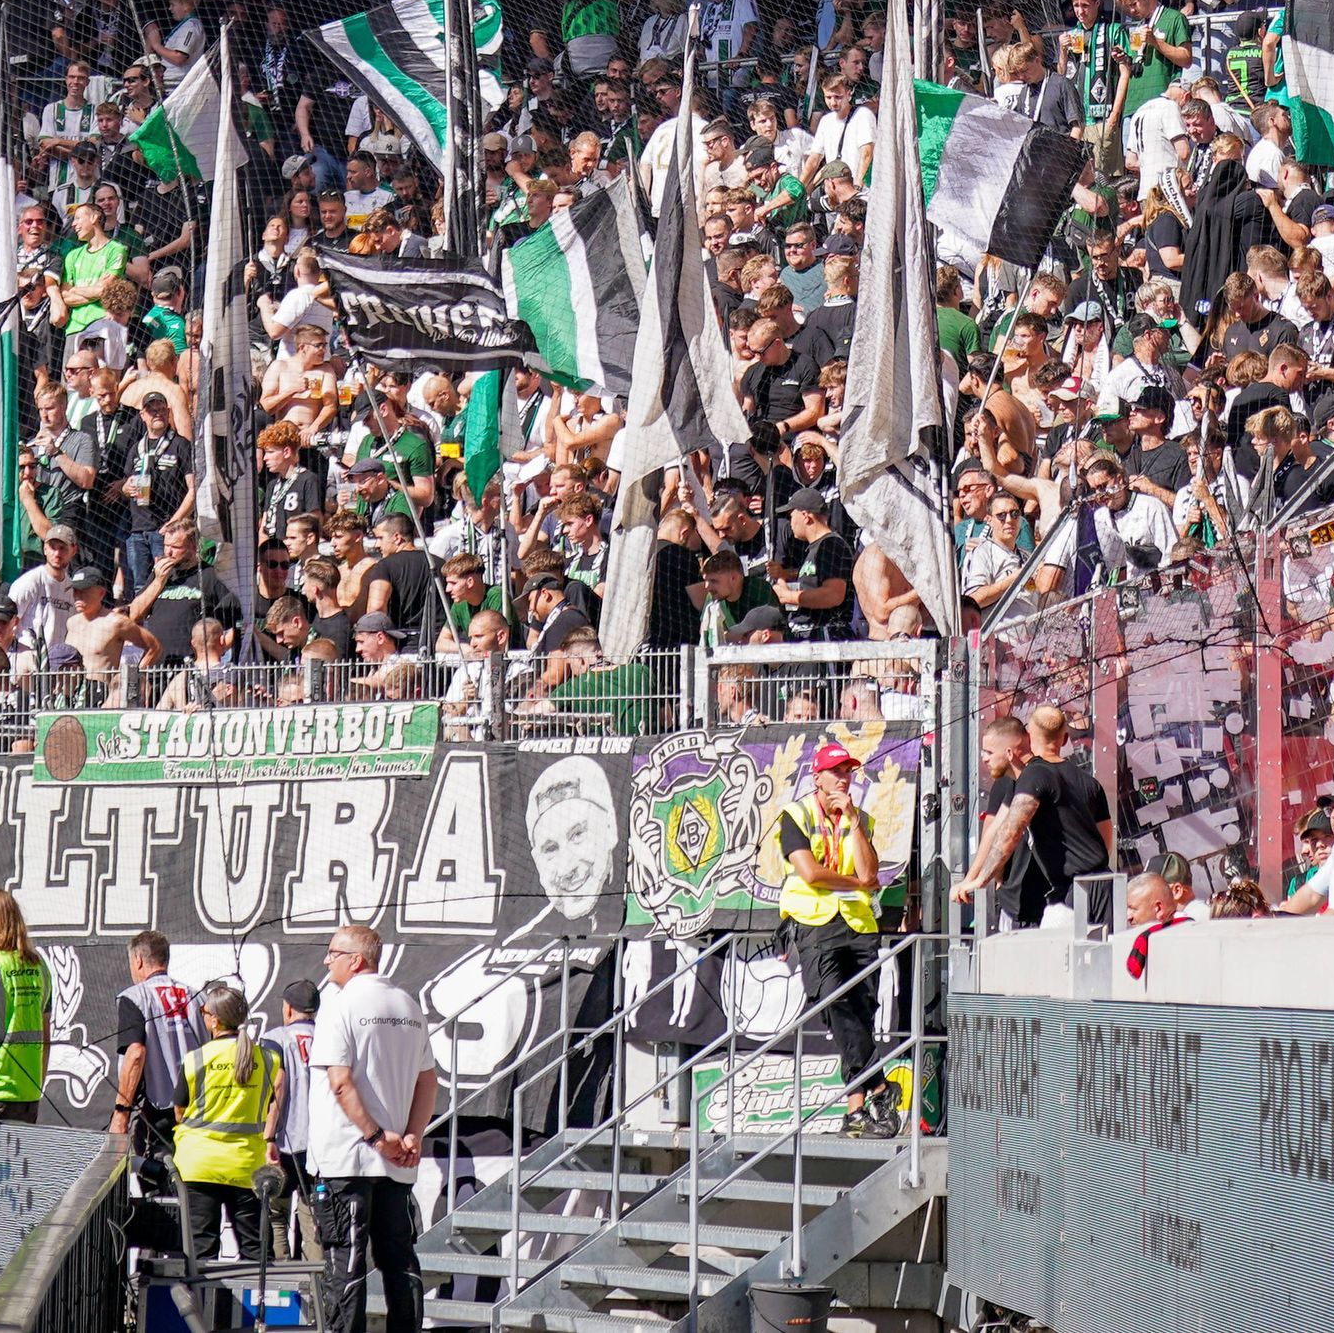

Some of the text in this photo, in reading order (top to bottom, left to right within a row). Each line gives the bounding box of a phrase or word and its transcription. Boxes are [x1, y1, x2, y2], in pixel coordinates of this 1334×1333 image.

[119, 704, 415, 759] STADIONVERBOT
[657, 736, 699, 761] NORD
[1076, 1021, 1203, 1157] PROJEKT KRAFT
